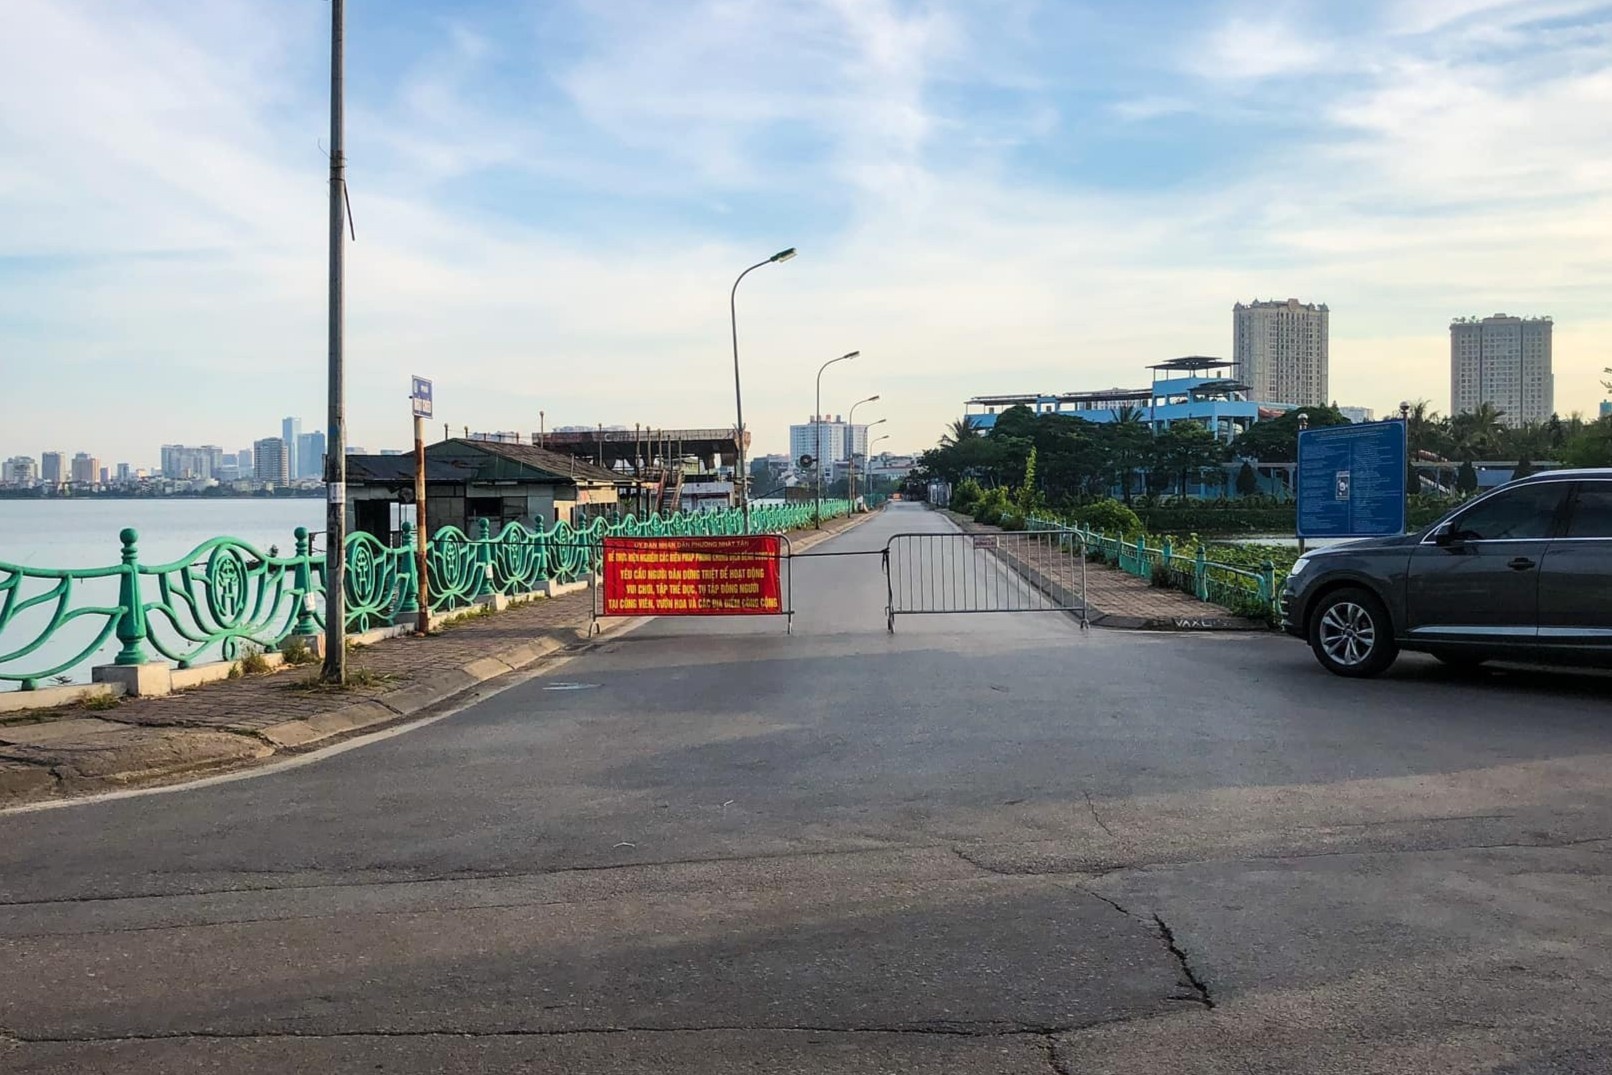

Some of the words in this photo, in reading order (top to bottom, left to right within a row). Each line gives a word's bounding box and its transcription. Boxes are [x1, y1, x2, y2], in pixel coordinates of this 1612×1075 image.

[621, 567, 632, 579] YÊU
[634, 567, 646, 579] CẦU
[648, 567, 667, 579] NGƯỜI
[668, 567, 681, 579] DÂN
[702, 567, 718, 580] TRIỆT
[720, 565, 728, 578] ĐỂ
[729, 568, 745, 580] HOẠT
[746, 567, 765, 580] ĐỘNG
[627, 585, 636, 594] VUI
[656, 583, 668, 596] TẬP
[669, 582, 681, 594] THỂ
[683, 584, 697, 596] DỤC,
[698, 584, 706, 595] TỤ
[707, 582, 719, 595] TẬP
[721, 582, 738, 593] ĐÔNG
[740, 582, 759, 593] NGƯỜI
[608, 599, 618, 611] TẠI
[620, 598, 636, 609] CÔNG
[638, 598, 655, 609] VIÊN,
[674, 599, 687, 609] HOA
[688, 597, 697, 609] VÀ
[698, 598, 711, 608] CÁC
[712, 599, 723, 610] ĐỊA
[742, 597, 758, 608] CÔNG
[760, 597, 778, 608] CỘNG
